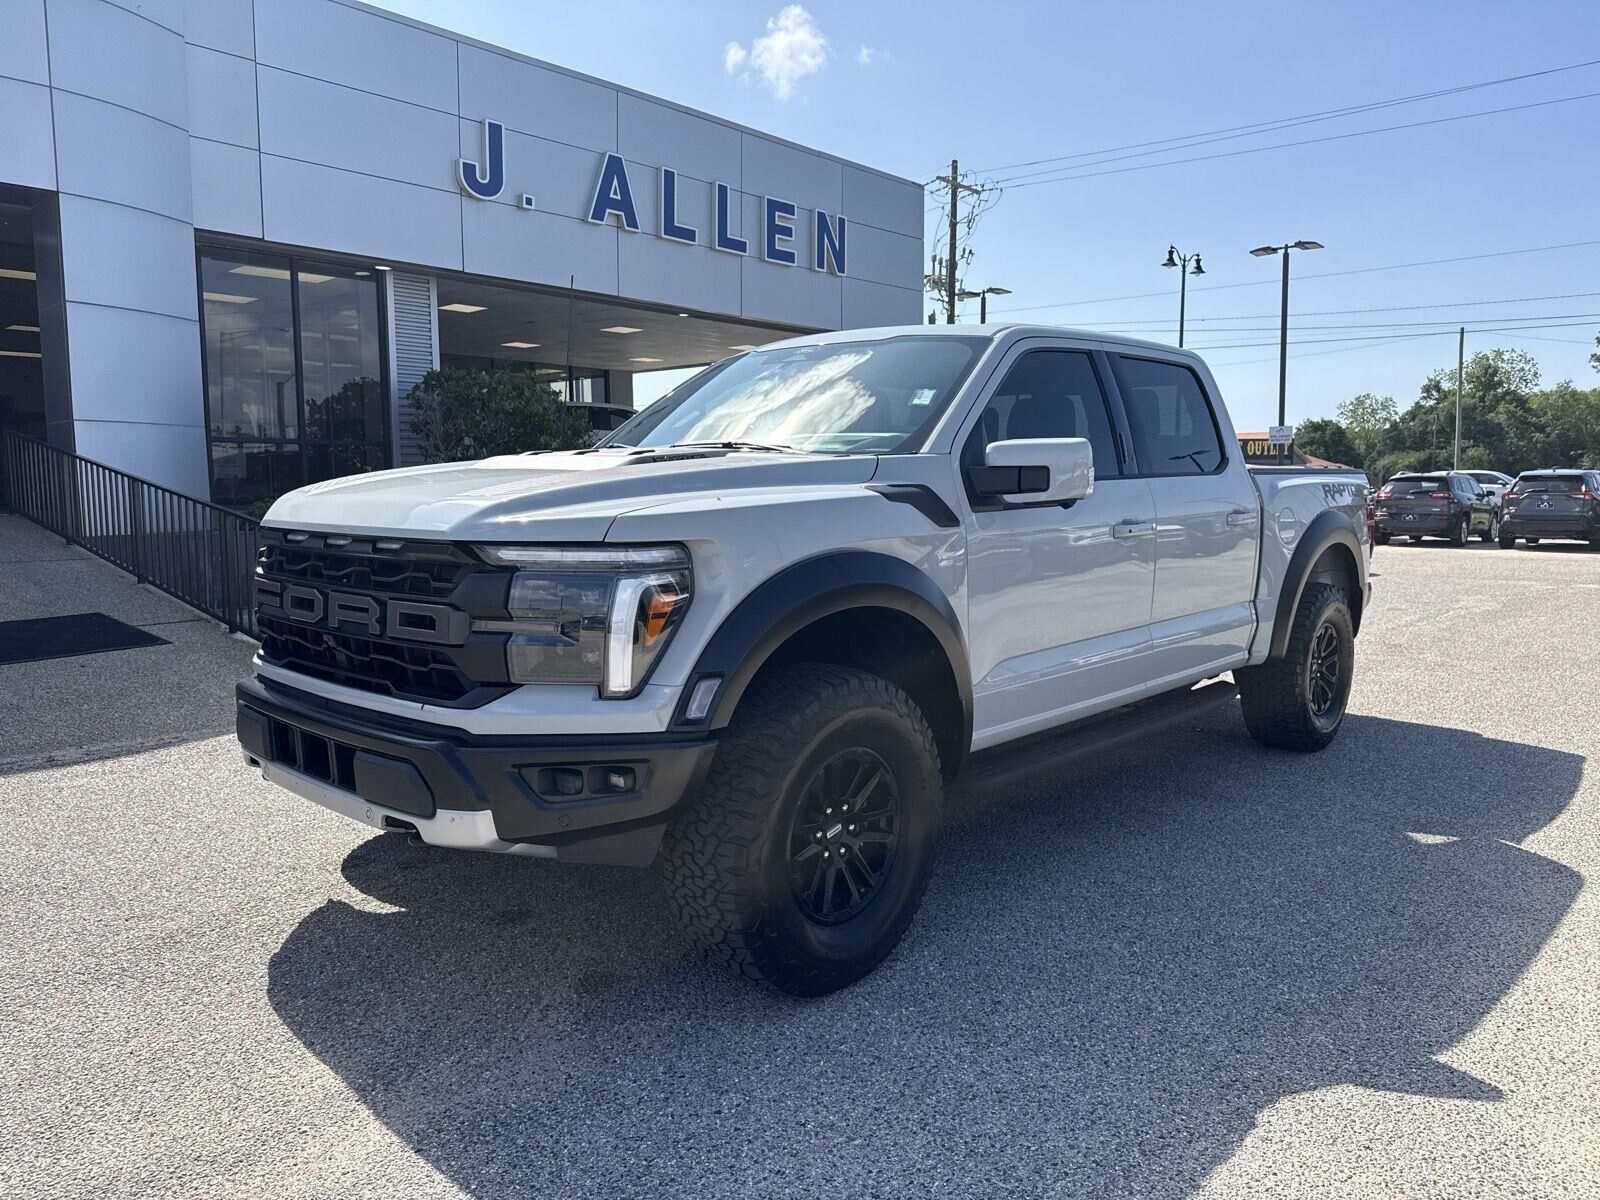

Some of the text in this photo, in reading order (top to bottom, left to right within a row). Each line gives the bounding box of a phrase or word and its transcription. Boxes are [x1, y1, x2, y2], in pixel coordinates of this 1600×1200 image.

[456, 118, 847, 277] J. ALLEN
[1247, 440, 1290, 456] OUTLT
[255, 580, 470, 645] FORD
